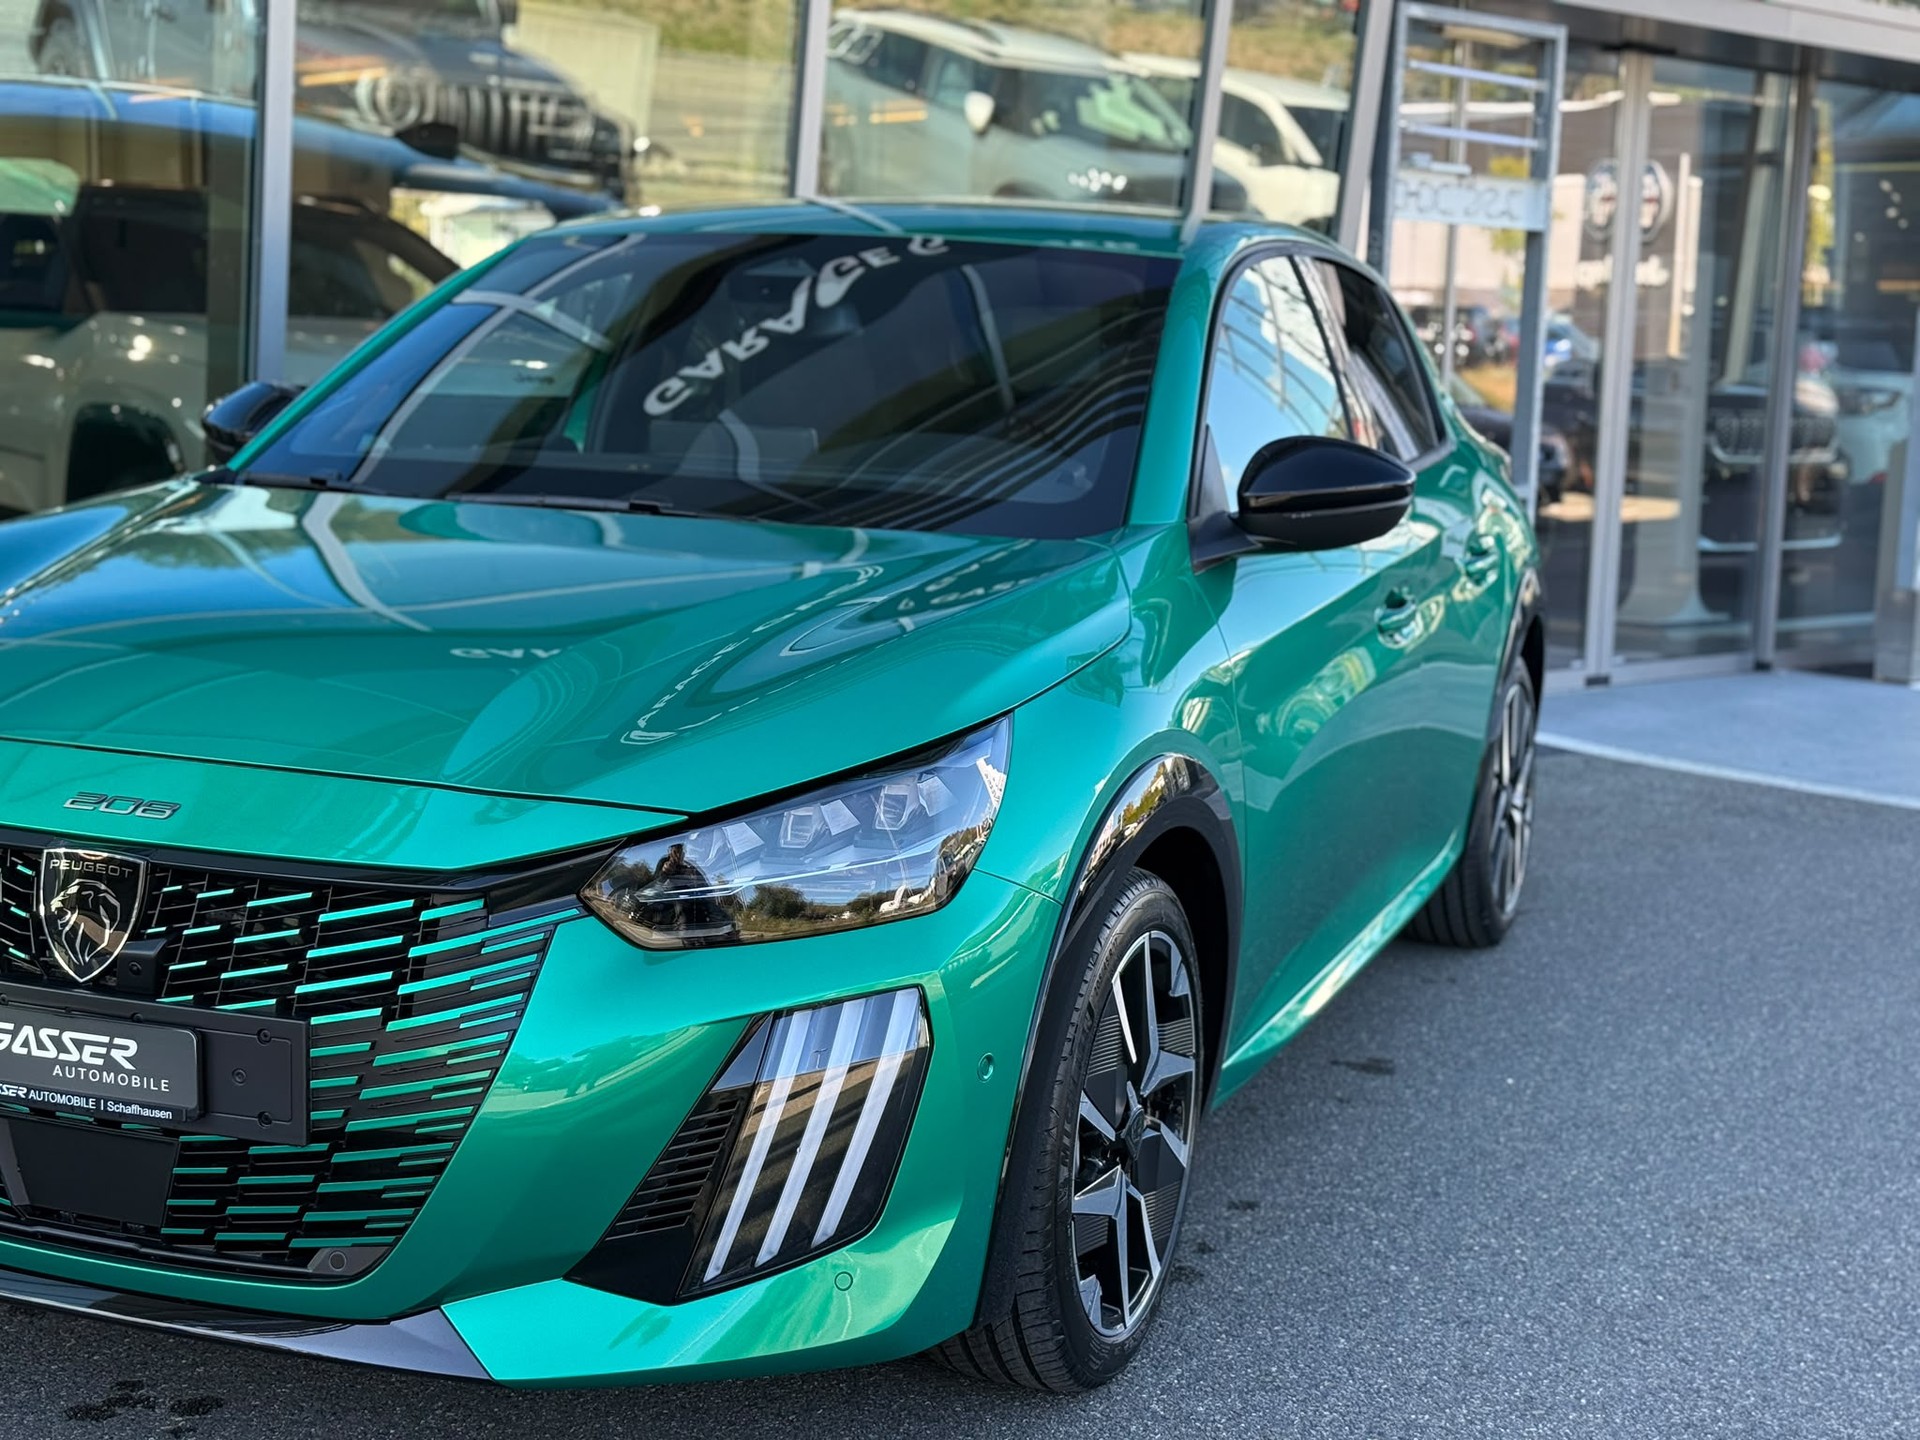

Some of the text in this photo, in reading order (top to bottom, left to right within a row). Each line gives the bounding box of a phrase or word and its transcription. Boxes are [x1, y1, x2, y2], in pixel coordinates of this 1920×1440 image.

[62, 791, 182, 820] 208
[49, 859, 133, 878] PEUGEOT
[53, 1065, 170, 1092] AUTOMOBILE
[28, 1089, 97, 1109] AUTOMOBILE
[107, 1100, 173, 1119] Schaffhausen
